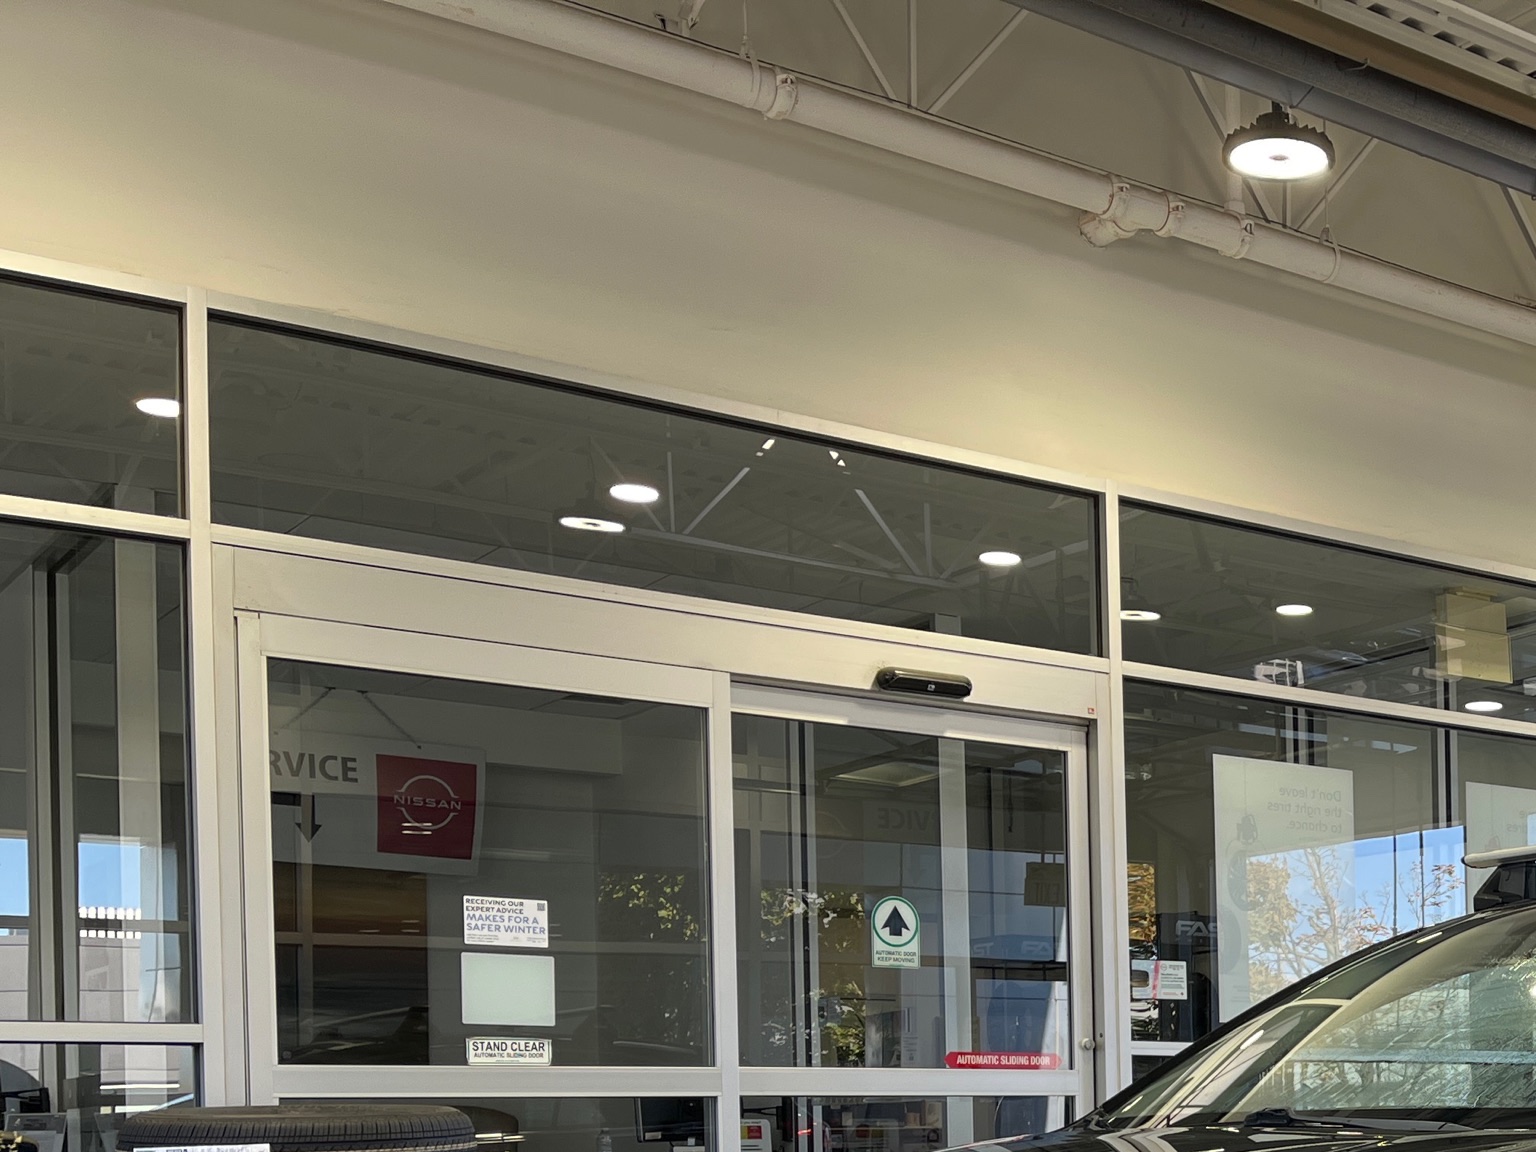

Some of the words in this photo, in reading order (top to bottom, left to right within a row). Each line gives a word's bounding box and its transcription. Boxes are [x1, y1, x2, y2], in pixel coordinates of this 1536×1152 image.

[394, 794, 462, 810] NISSAN
[465, 898, 506, 906] RECEIVING
[465, 905, 495, 913] EXPERT
[466, 913, 505, 923] MAKES
[507, 915, 530, 925] FOR
[531, 917, 539, 925] A
[466, 923, 502, 933] SAFER
[503, 925, 546, 935] WINTER
[472, 1041, 508, 1051] STAND
[510, 1041, 545, 1052] CLEAR
[956, 1054, 999, 1065] AUTOMATIC
[1000, 1055, 1029, 1065] SLIDING
[1030, 1055, 1051, 1066] DOOR
